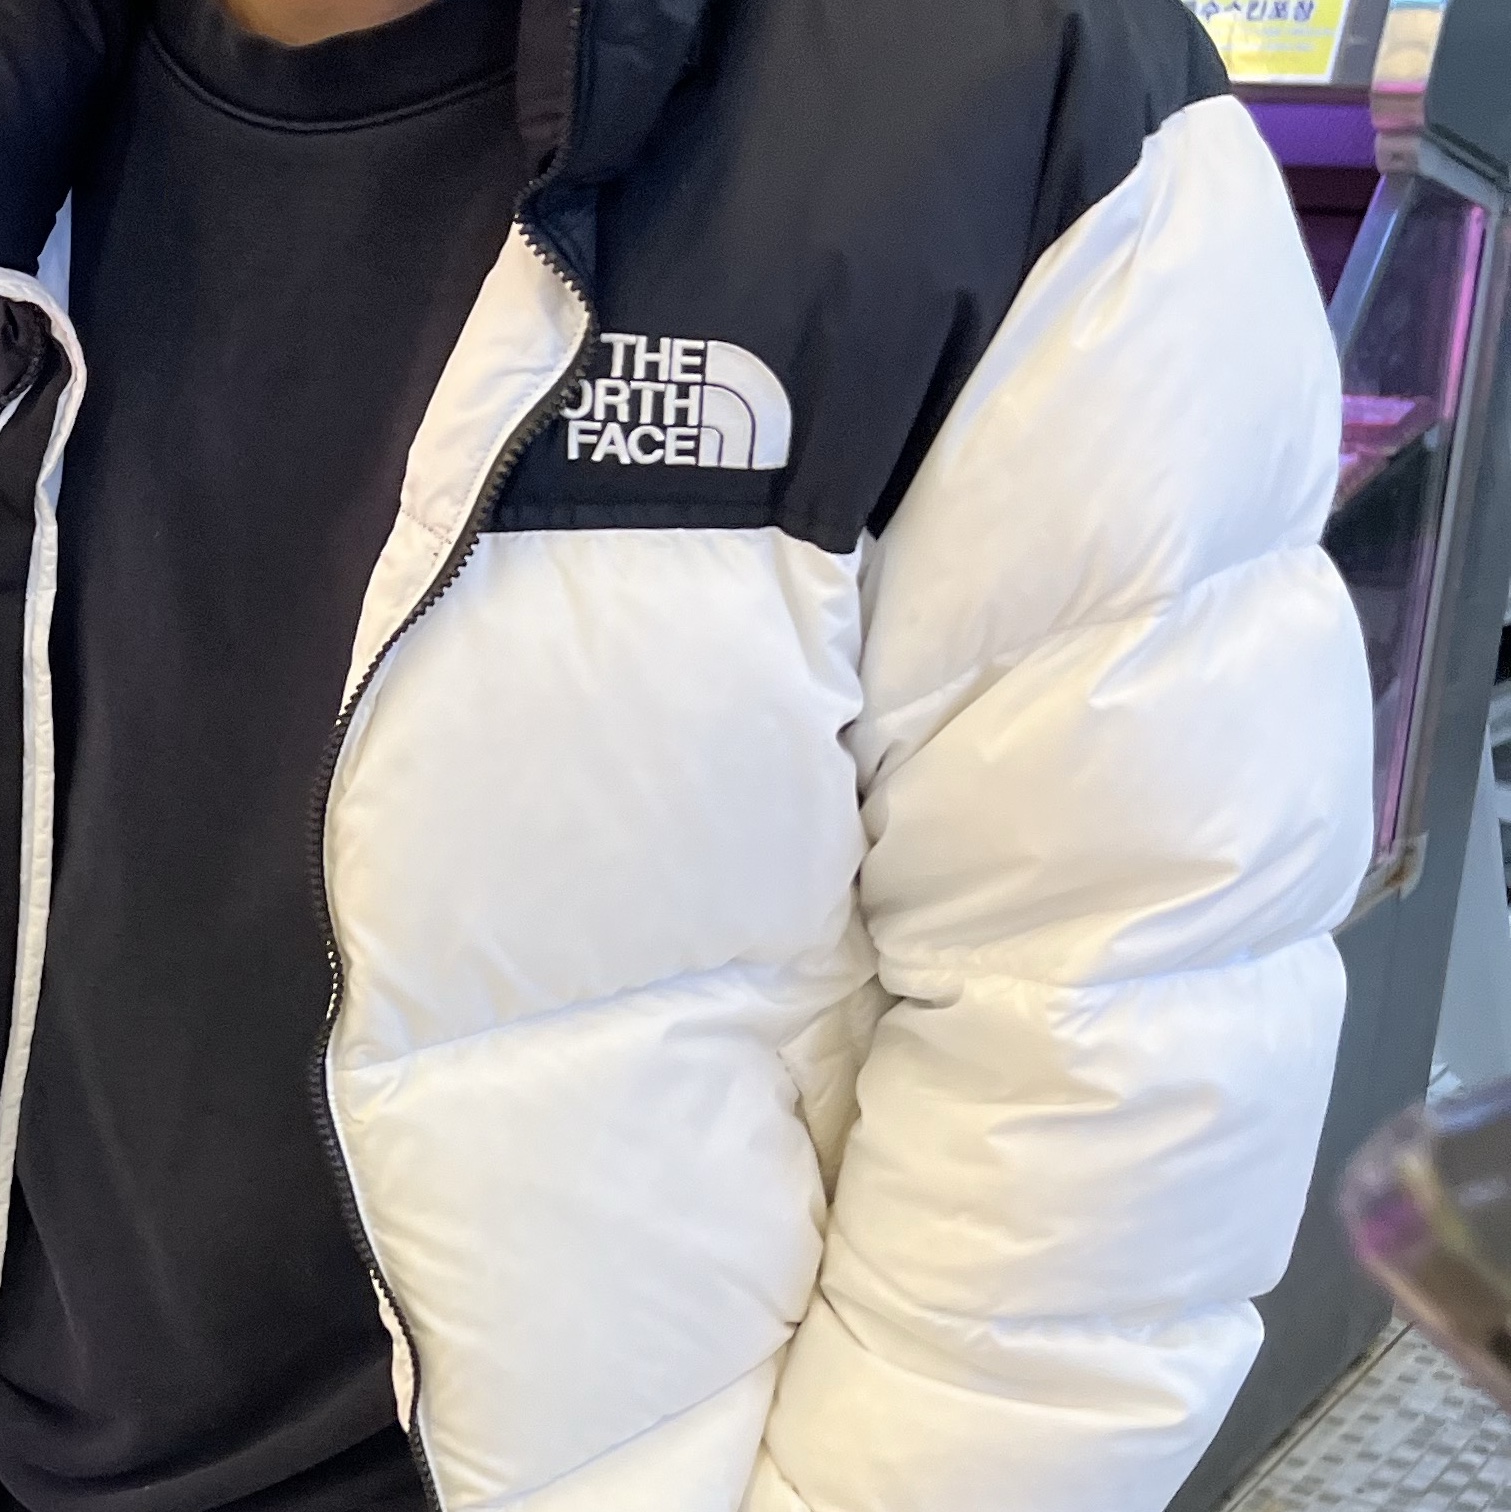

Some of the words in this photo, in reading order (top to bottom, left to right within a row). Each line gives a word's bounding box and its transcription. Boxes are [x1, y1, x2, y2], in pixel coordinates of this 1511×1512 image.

[600, 333, 706, 383] THE
[559, 378, 701, 427] ORTH
[567, 420, 699, 466] FACE
